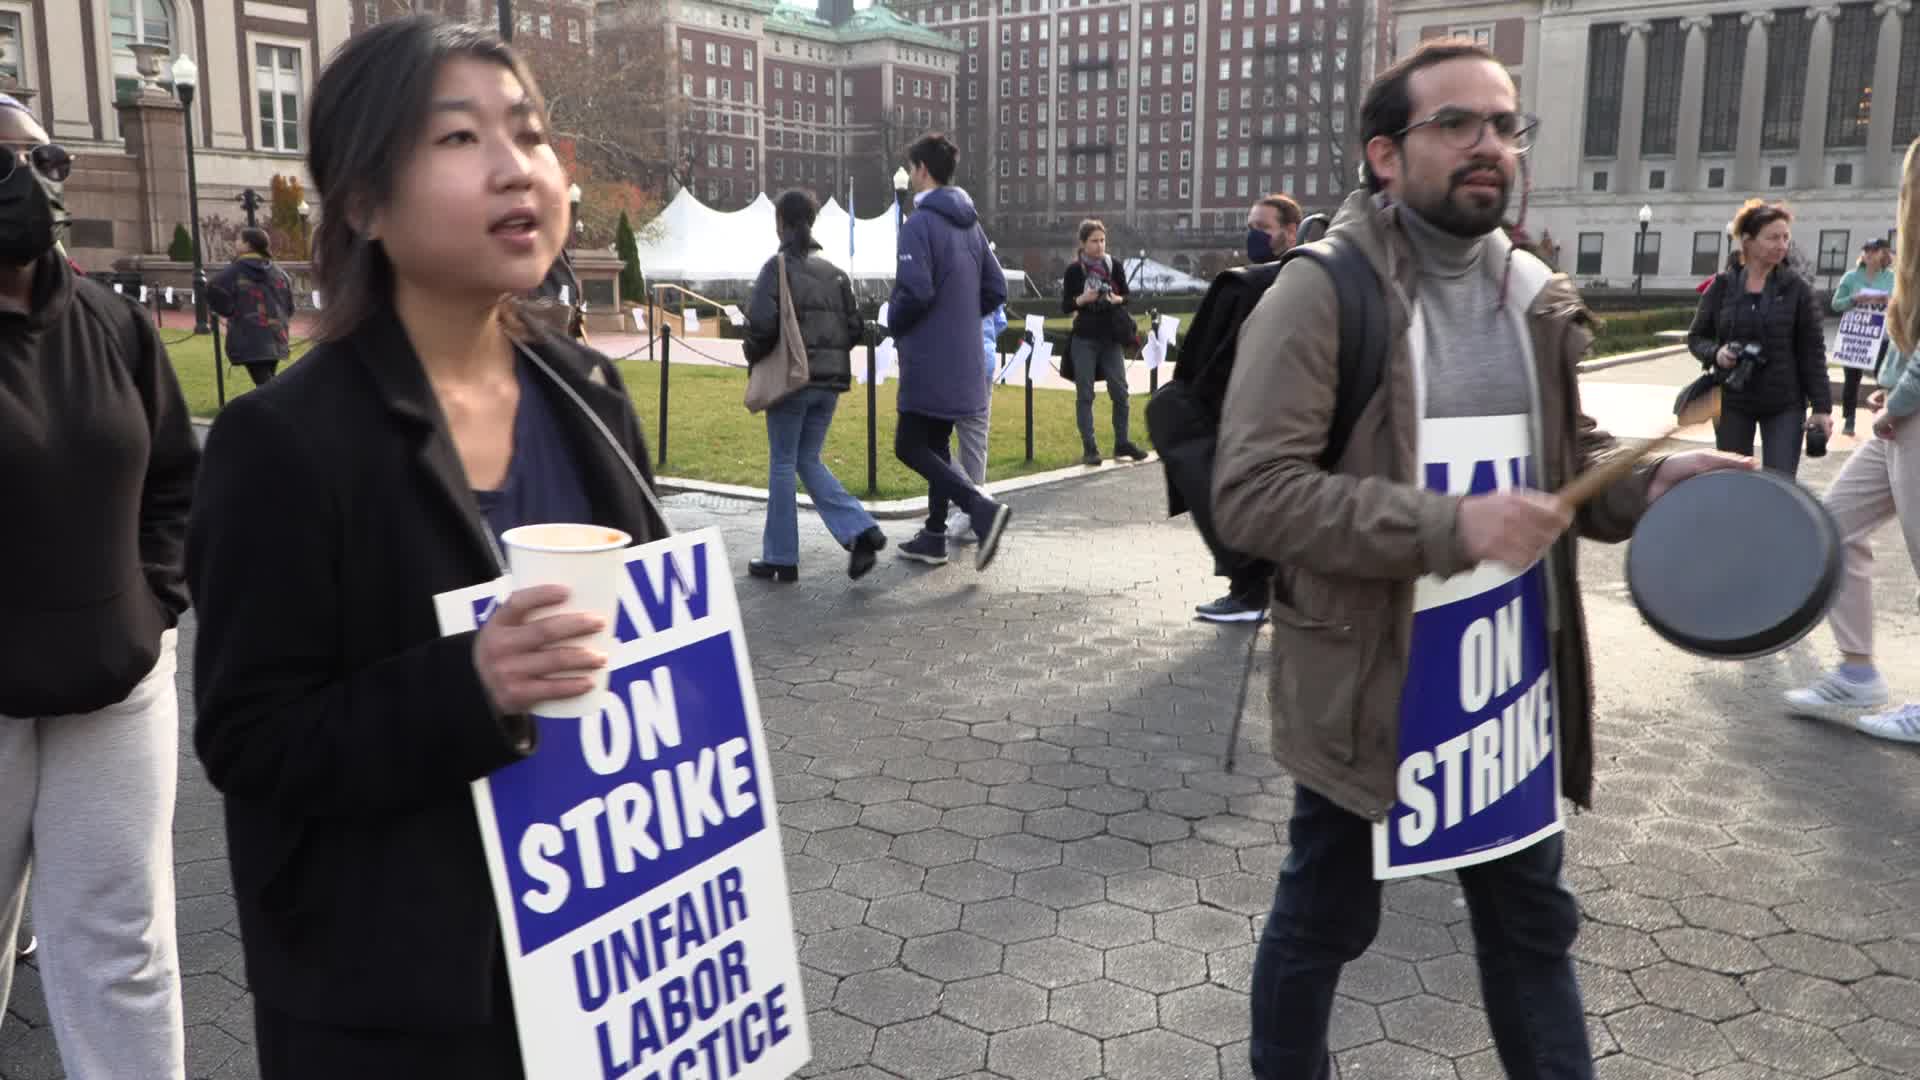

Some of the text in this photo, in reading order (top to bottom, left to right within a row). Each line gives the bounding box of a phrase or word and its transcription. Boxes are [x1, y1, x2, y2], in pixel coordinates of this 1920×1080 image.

[580, 665, 681, 775] ON
[1459, 595, 1522, 714] ON
[518, 736, 757, 914] STRIKE
[1397, 669, 1552, 847] STRIKE
[571, 866, 749, 1013] UNFAIR
[594, 939, 751, 1080] LABOR
[641, 982, 791, 1080] CTICE
